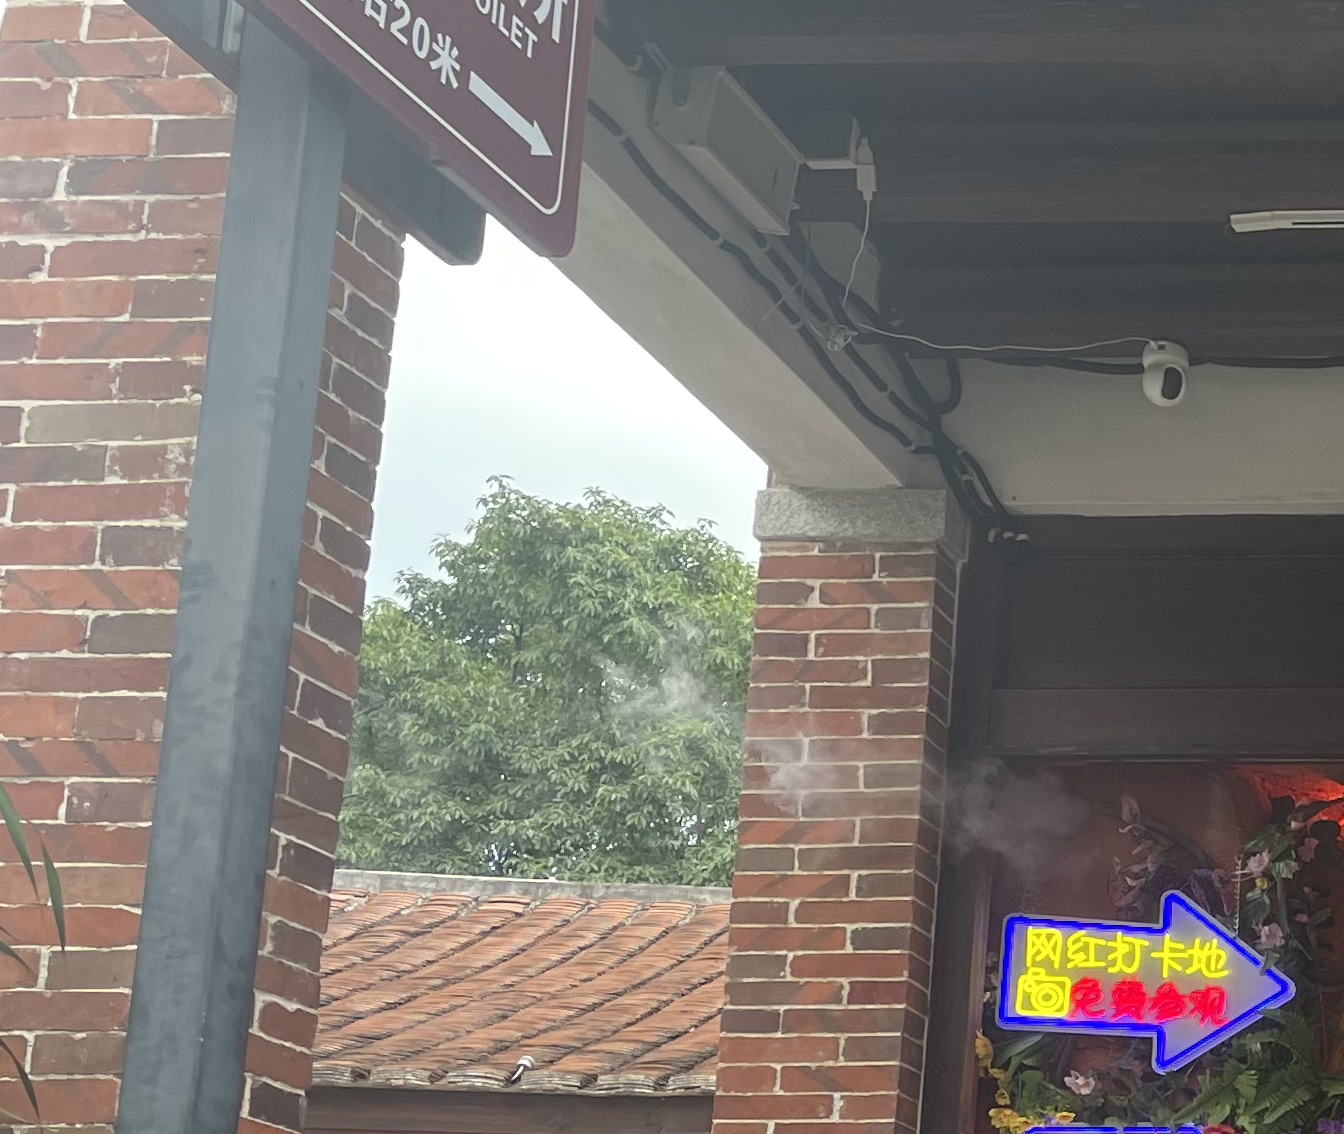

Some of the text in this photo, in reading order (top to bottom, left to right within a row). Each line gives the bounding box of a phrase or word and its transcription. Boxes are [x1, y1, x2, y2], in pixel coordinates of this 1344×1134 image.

[1026, 926, 1229, 979] 网红打卡地
[1070, 976, 1230, 1027] 免费参观
